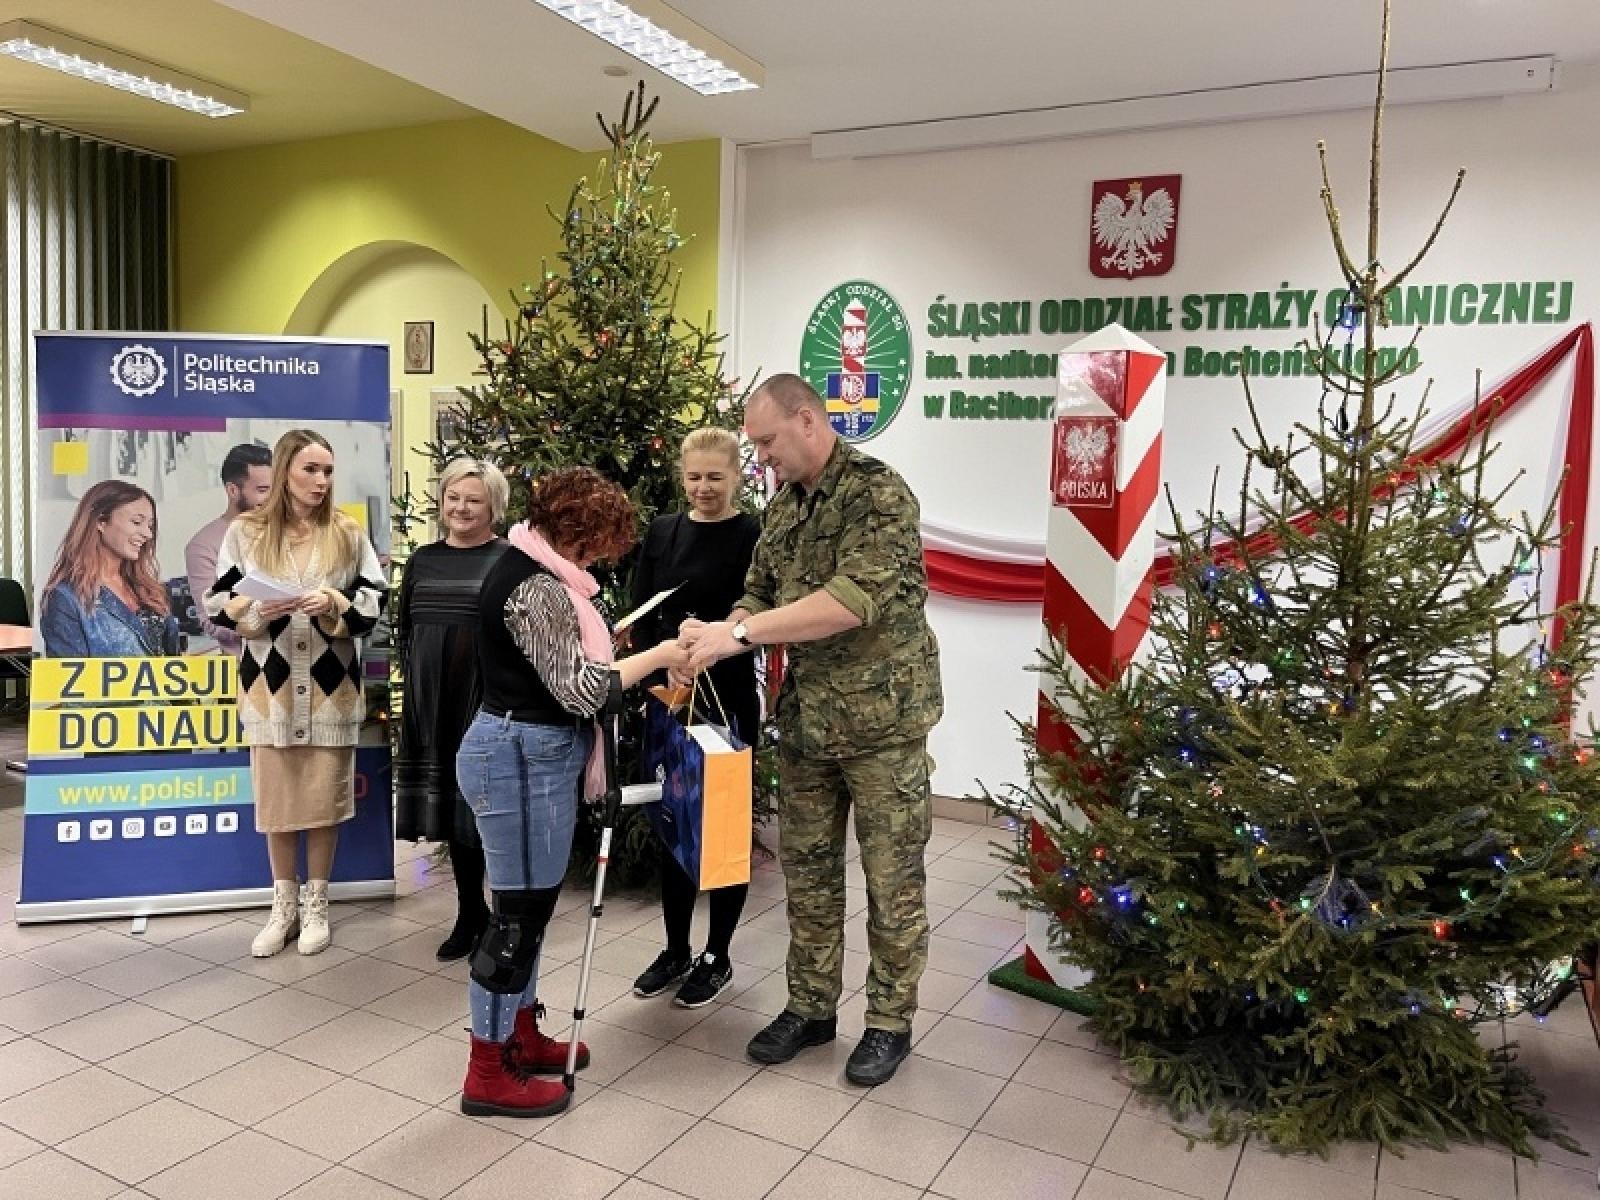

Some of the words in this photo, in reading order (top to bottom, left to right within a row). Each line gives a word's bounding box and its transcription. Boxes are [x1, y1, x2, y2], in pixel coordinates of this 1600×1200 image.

[927, 294, 1032, 342] ŚLĄSKI
[1039, 295, 1174, 334] ODDZIAŁ
[1181, 281, 1319, 331] STRAŻY
[1324, 281, 1575, 329] GANICZNEJ
[184, 353, 320, 376] Politechnika
[925, 350, 963, 379] im.
[184, 370, 256, 395] Śląska
[923, 395, 945, 420] w
[1060, 480, 1108, 499] POLSKA
[60, 661, 85, 699] Z
[101, 659, 230, 698] PASJI
[59, 711, 119, 750] DO
[58, 773, 238, 808] www.polsl.pl
